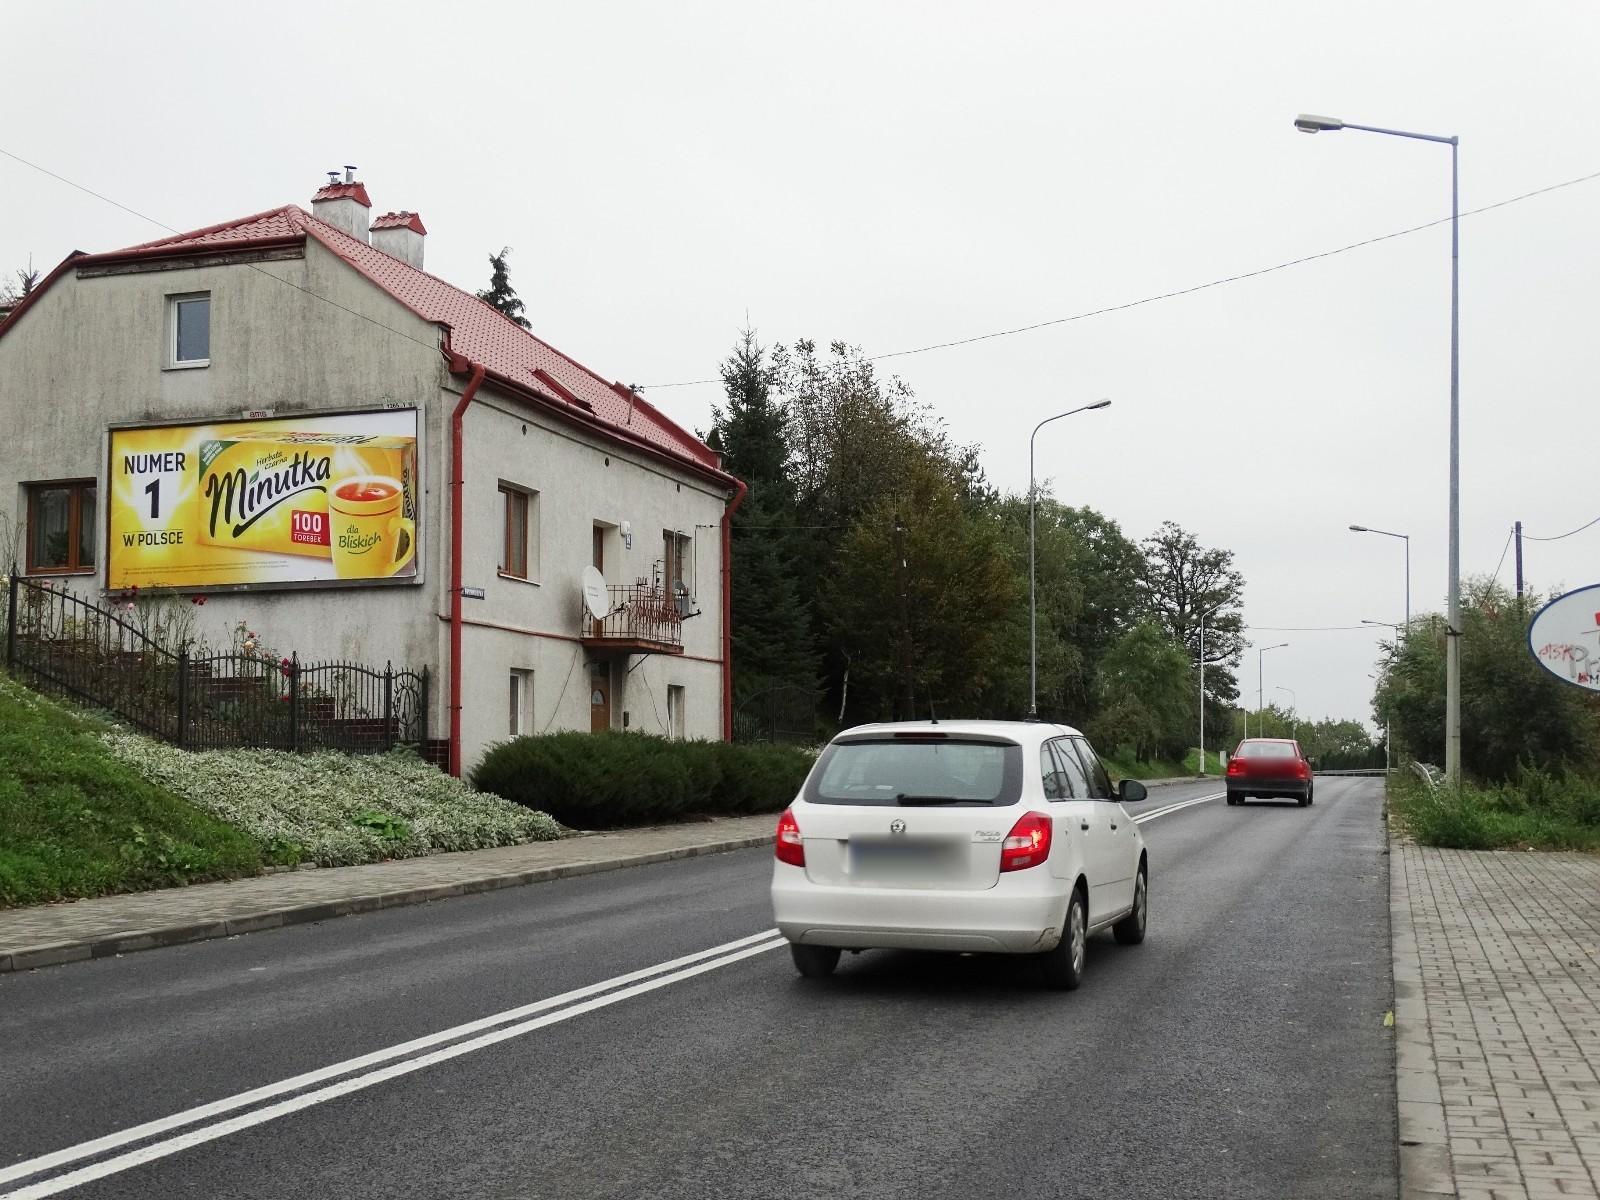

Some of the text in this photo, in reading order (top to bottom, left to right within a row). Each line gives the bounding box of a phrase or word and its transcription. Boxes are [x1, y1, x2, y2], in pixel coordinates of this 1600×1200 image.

[124, 452, 186, 475] NUMER
[144, 478, 160, 519] 1
[205, 450, 331, 538] Minutka
[293, 512, 322, 533] 100
[346, 524, 359, 535] dla
[122, 531, 184, 547] W POLSCE
[293, 533, 322, 544] TOREBEK
[338, 534, 383, 550] Bliskich
